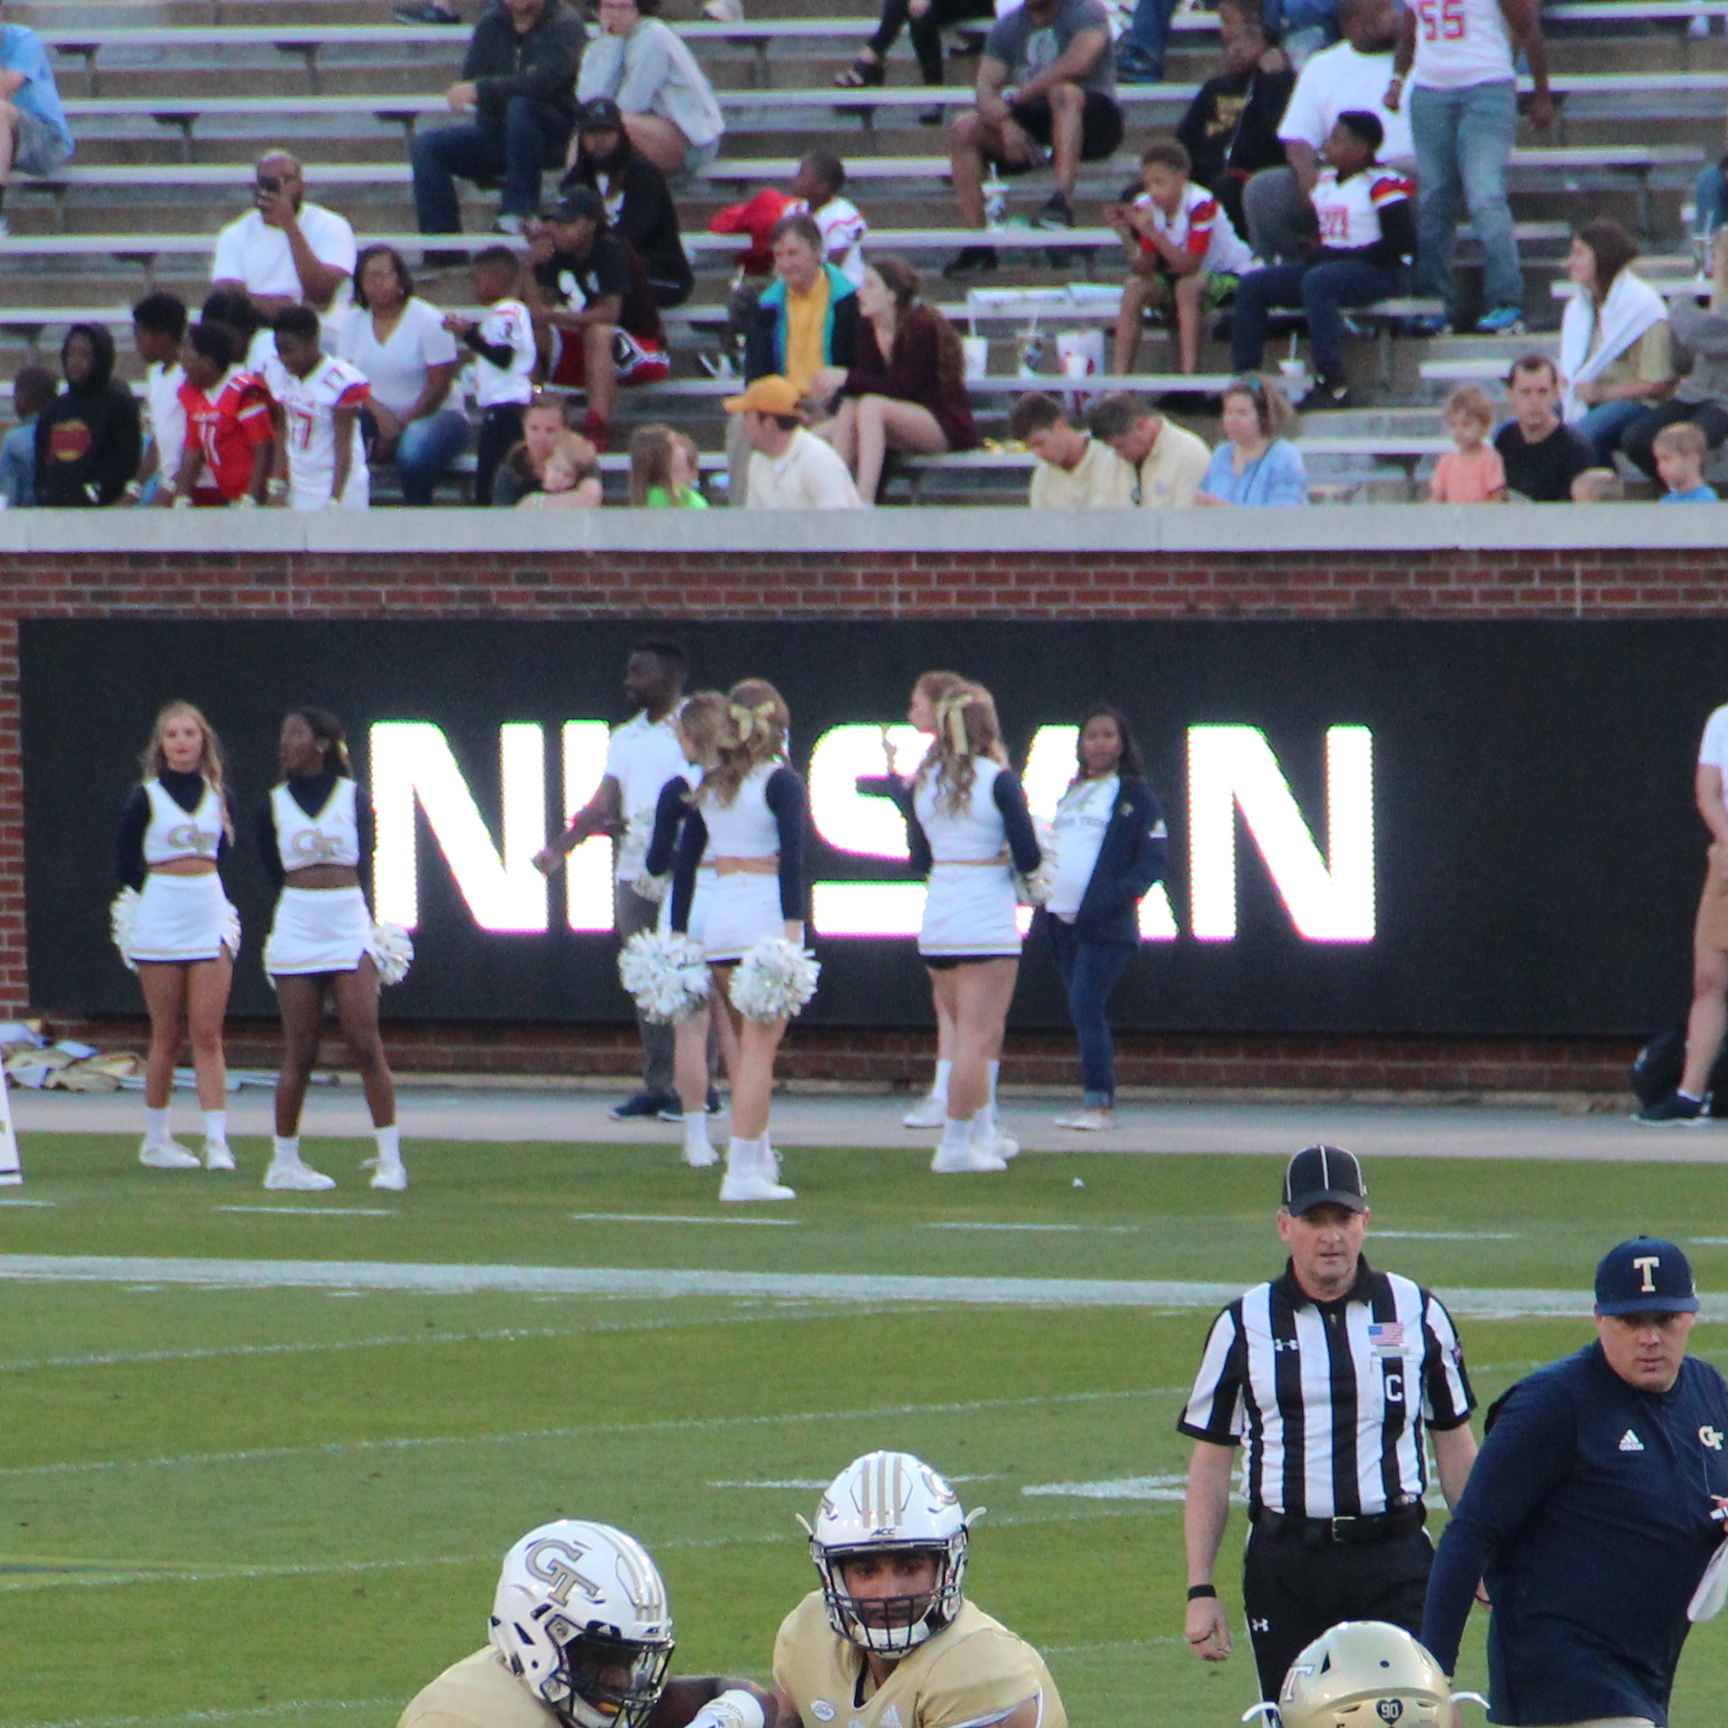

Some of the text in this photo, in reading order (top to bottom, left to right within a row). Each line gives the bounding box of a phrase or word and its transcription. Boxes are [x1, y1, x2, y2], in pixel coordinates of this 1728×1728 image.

[168, 823, 217, 855] GT
[291, 829, 344, 858] GT
[1632, 1256, 1660, 1292] T
[1384, 1373, 1404, 1402] C
[1698, 1425, 1725, 1451] GT
[524, 1538, 600, 1607] GT
[1378, 1702, 1401, 1720] 90
